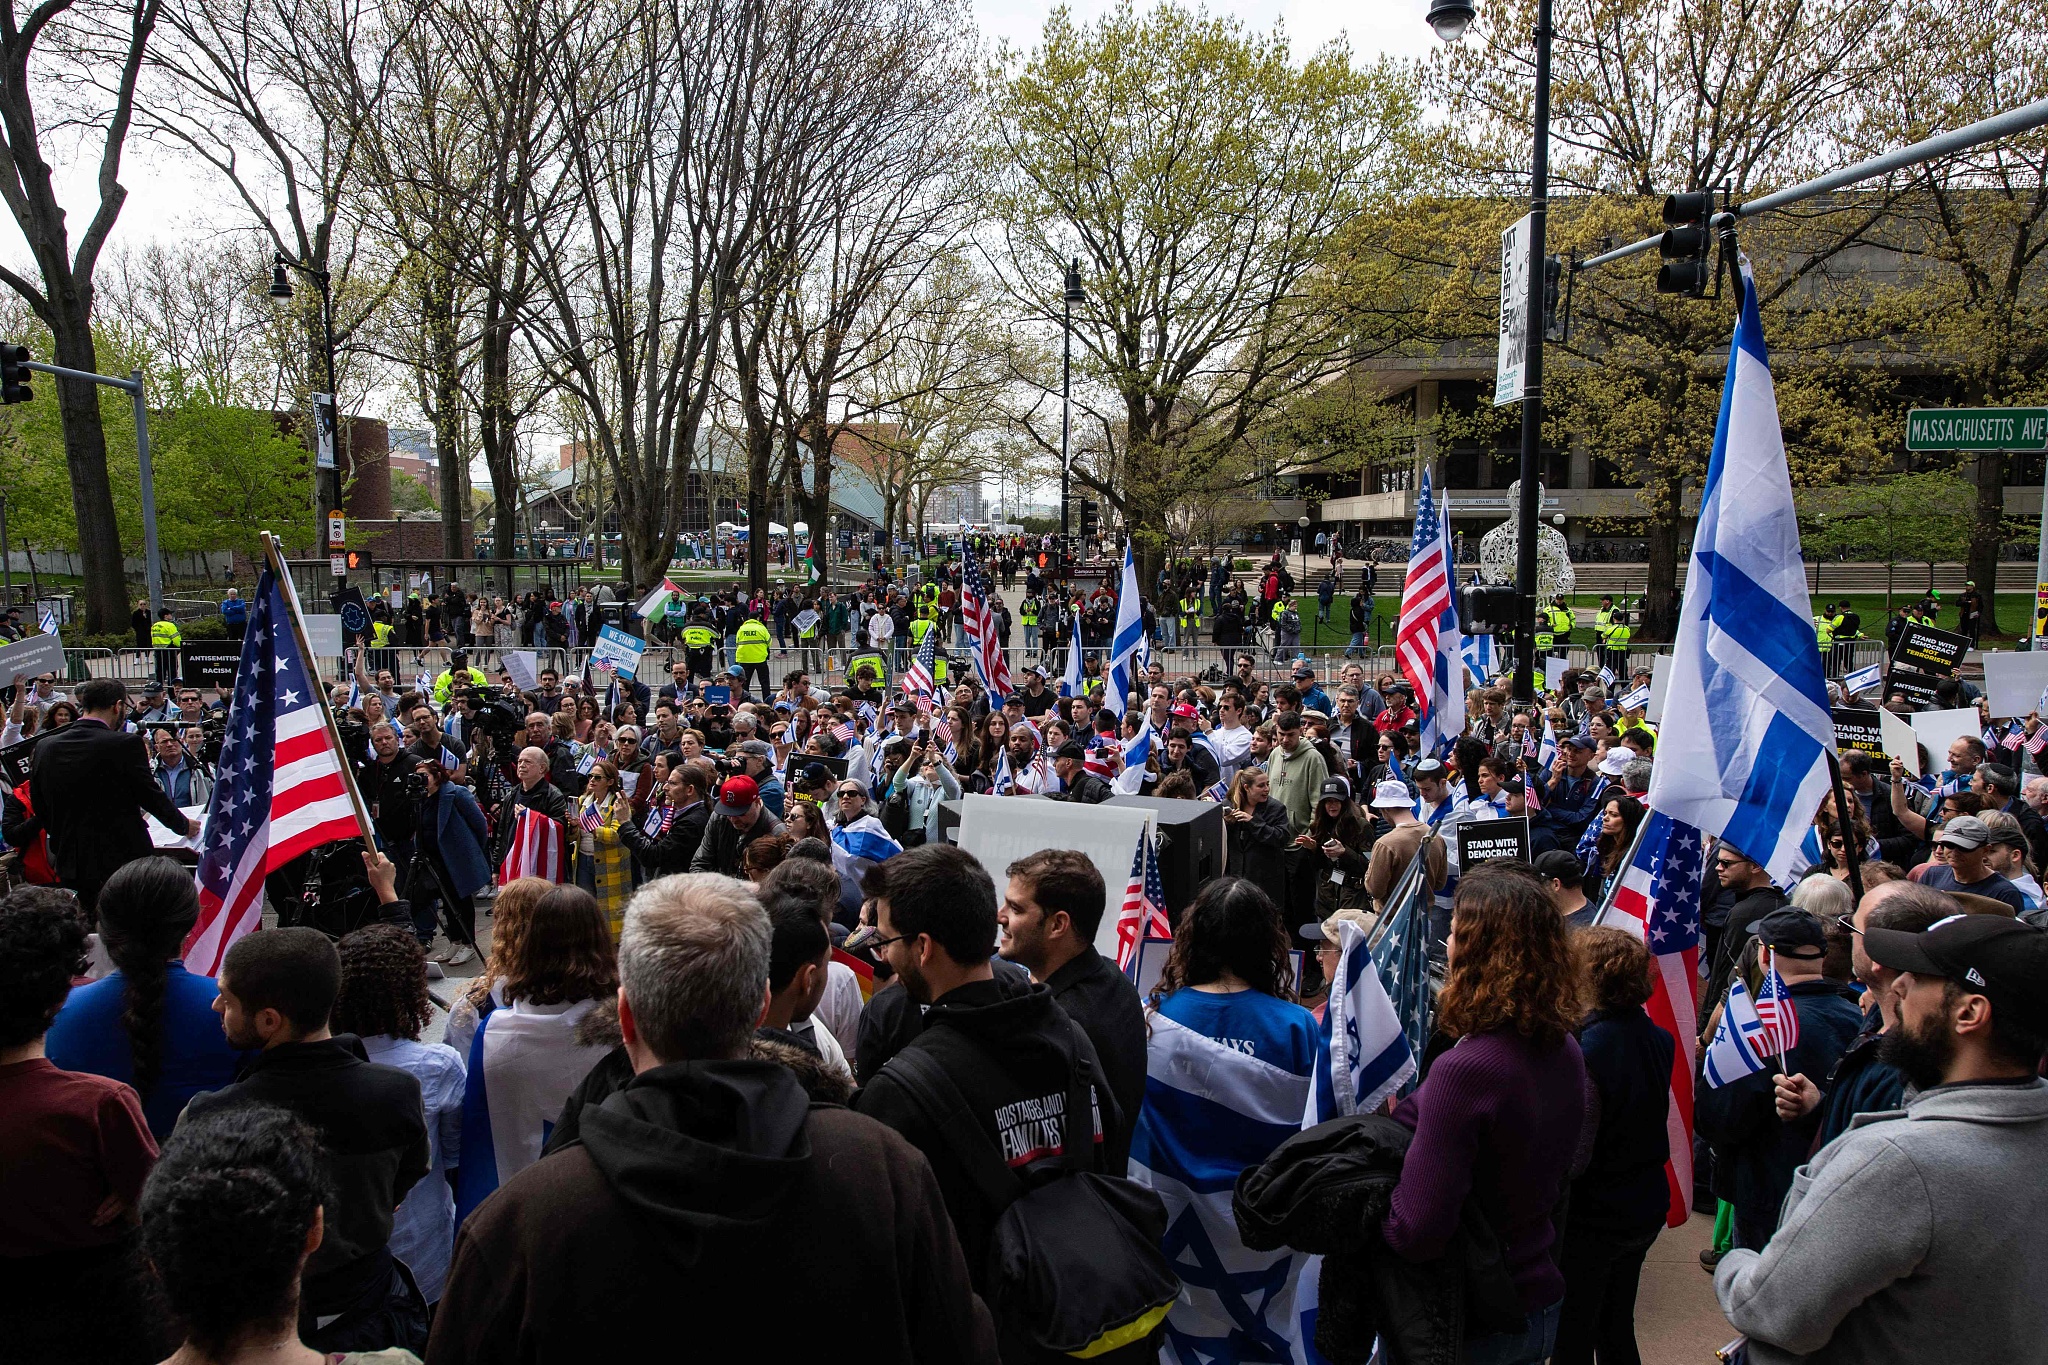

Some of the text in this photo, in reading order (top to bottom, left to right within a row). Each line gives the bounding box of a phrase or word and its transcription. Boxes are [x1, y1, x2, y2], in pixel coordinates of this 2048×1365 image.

[1911, 417, 2046, 442] MASSACHUSETTS AVE
[608, 630, 637, 648] WE STAND
[1912, 634, 1958, 651] STAND WITH
[595, 648, 605, 656] AND
[602, 643, 634, 661] AGAINST HATE
[1910, 639, 1957, 656] DEMOCRACY
[1923, 648, 1939, 656] NOT
[1906, 648, 1952, 666] TERRORISTS!
[1893, 682, 1937, 695] ANTISEMITIS
[1907, 696, 1930, 705] ACISM
[1866, 726, 1882, 735] WI
[1833, 732, 1883, 743] DEMOCRA
[1852, 741, 1875, 750] NOT
[1467, 838, 1518, 850] STAND WITH
[1467, 848, 1519, 859] DEMOCRACY
[995, 1098, 1045, 1131] HOSTAGES
[1042, 1093, 1064, 1118] AND
[1000, 1117, 1062, 1162] FAMILIES
